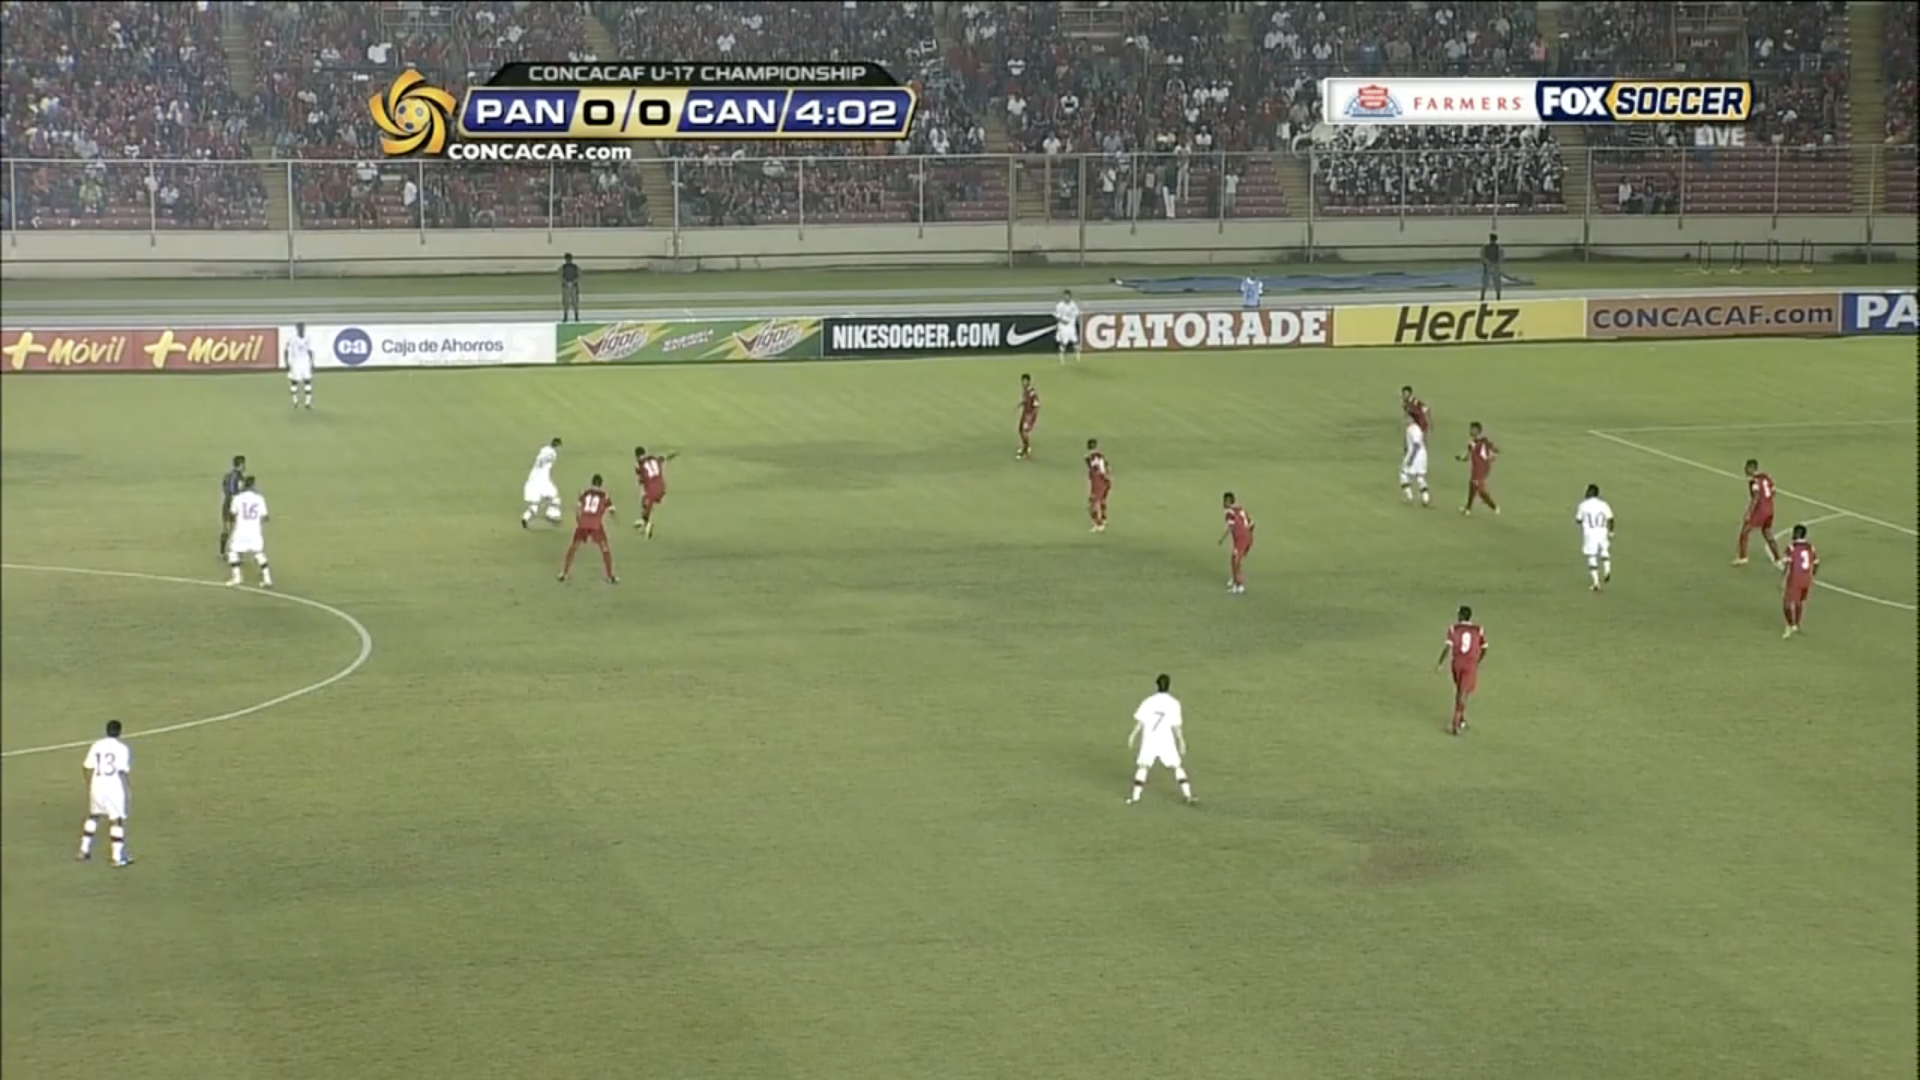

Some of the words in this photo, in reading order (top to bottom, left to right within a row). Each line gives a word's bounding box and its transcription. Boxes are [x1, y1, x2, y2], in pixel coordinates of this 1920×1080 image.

[1085, 310, 1328, 349] GATORADE
[1394, 304, 1521, 344] Hertz
[1593, 304, 1833, 330] CONCACAF.com
[381, 338, 416, 356] Caja
[418, 338, 439, 353] de
[440, 338, 504, 353] Ahorros
[831, 321, 1001, 350] NIKESOCCER.COM
[1586, 511, 1606, 529] 10
[1153, 711, 1166, 732] 7
[95, 752, 116, 777] 13
